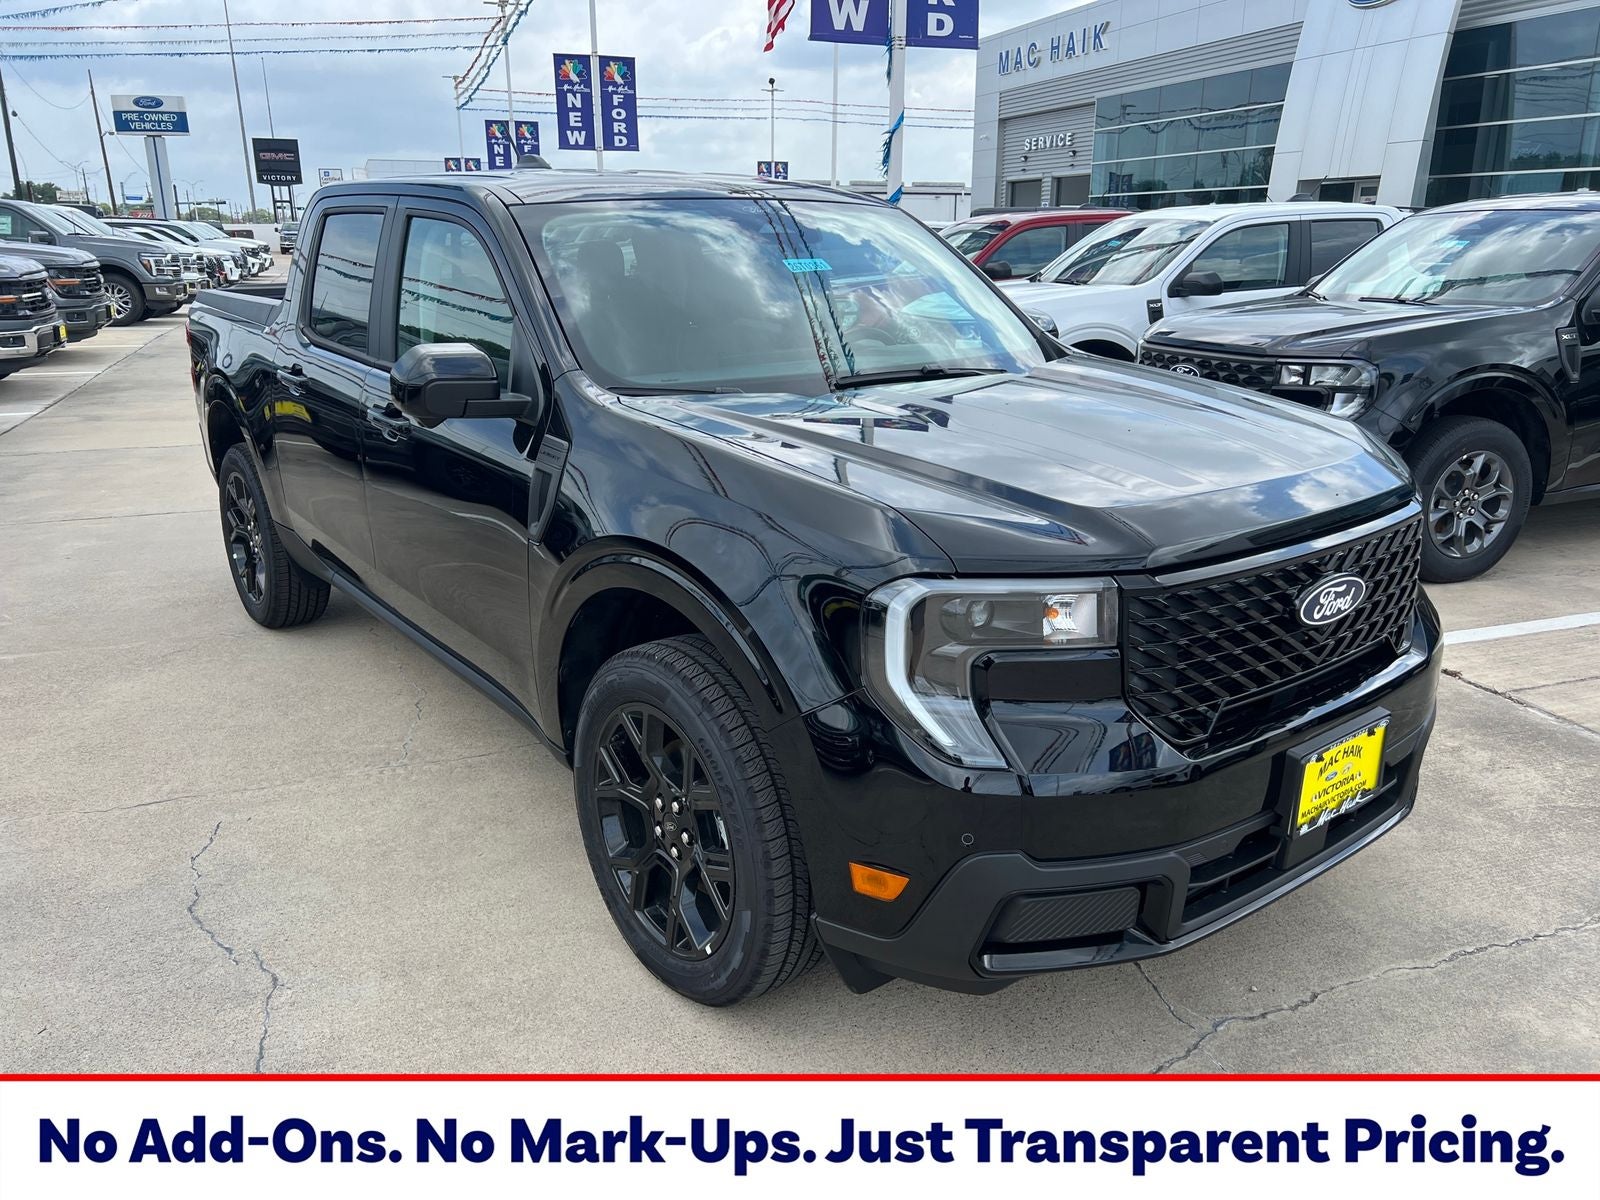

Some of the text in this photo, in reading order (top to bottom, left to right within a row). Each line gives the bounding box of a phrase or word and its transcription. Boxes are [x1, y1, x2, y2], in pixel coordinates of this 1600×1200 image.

[927, 0, 955, 37] D
[998, 22, 1107, 75] MAC HAIK
[121, 112, 178, 121] PRE-OWNED
[128, 122, 174, 130] VEHICLES
[566, 93, 587, 146] NEW
[611, 94, 628, 147] FORD
[259, 152, 295, 160] GMC
[1024, 133, 1072, 151] SERVICE
[262, 174, 297, 182] VICTORY
[1313, 584, 1356, 620] Ford
[1317, 750, 1341, 780] MAC
[1342, 744, 1363, 759] HAIK
[1317, 774, 1355, 799] VICTORIA
